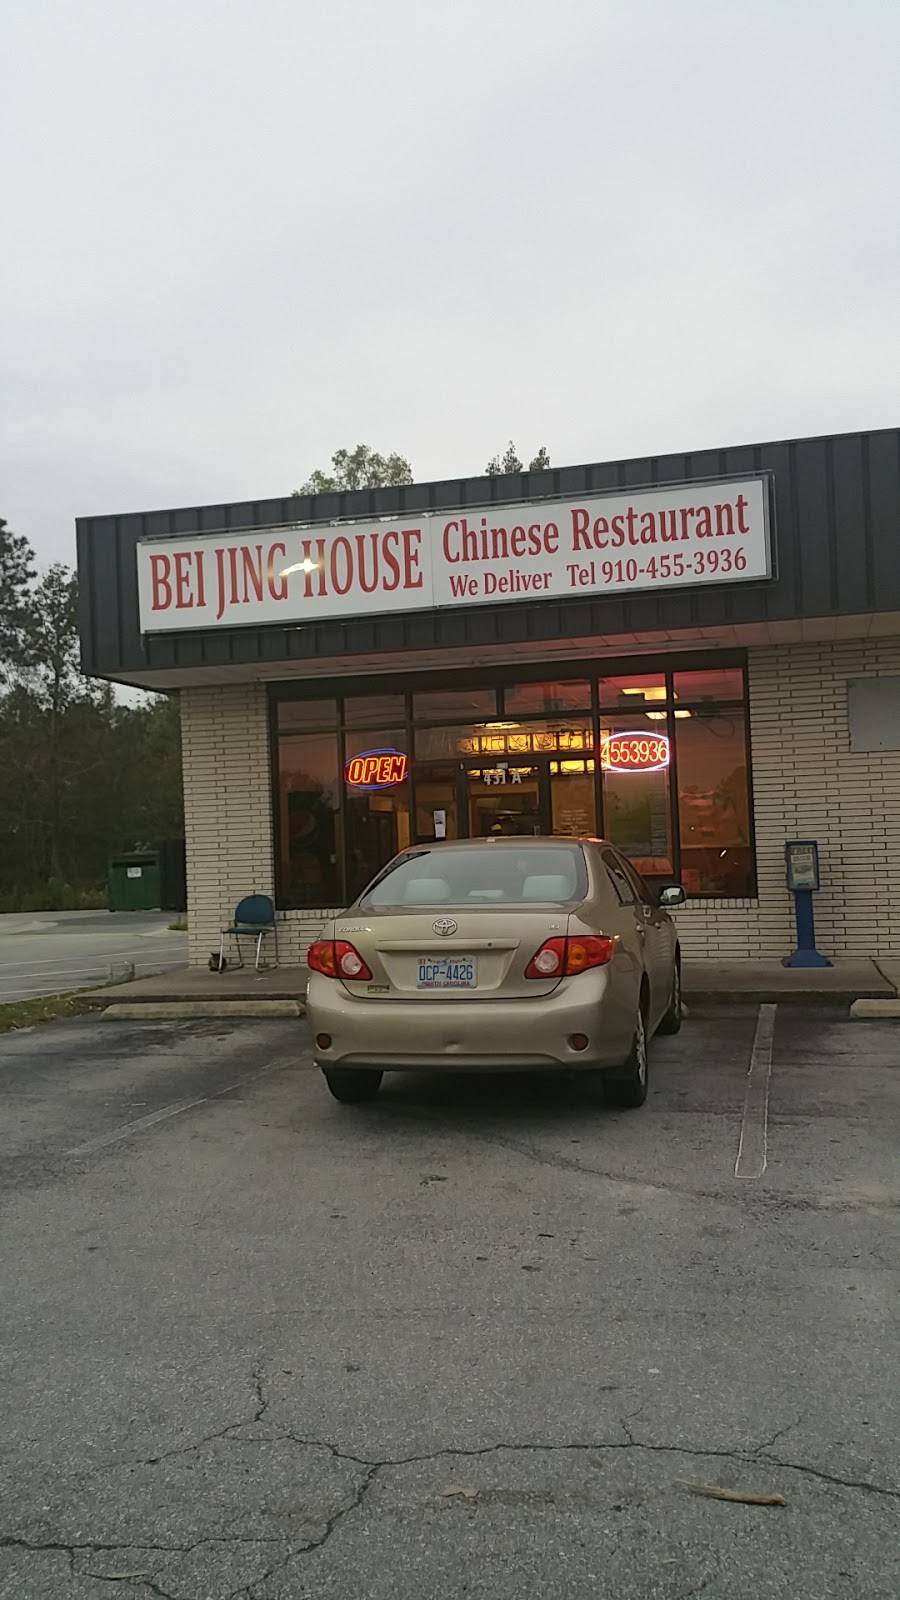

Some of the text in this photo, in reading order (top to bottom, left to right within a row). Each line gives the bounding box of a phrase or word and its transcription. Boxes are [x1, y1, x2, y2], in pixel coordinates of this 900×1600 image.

[442, 493, 751, 564] Chinese Restaurant
[302, 529, 423, 598] HOUSE
[449, 546, 748, 598] We Deliver Tel 910-455-3936
[600, 740, 668, 764] 4553936
[348, 756, 406, 784] OPEN
[511, 771, 522, 785] A
[419, 965, 473, 981] DCP-4426
